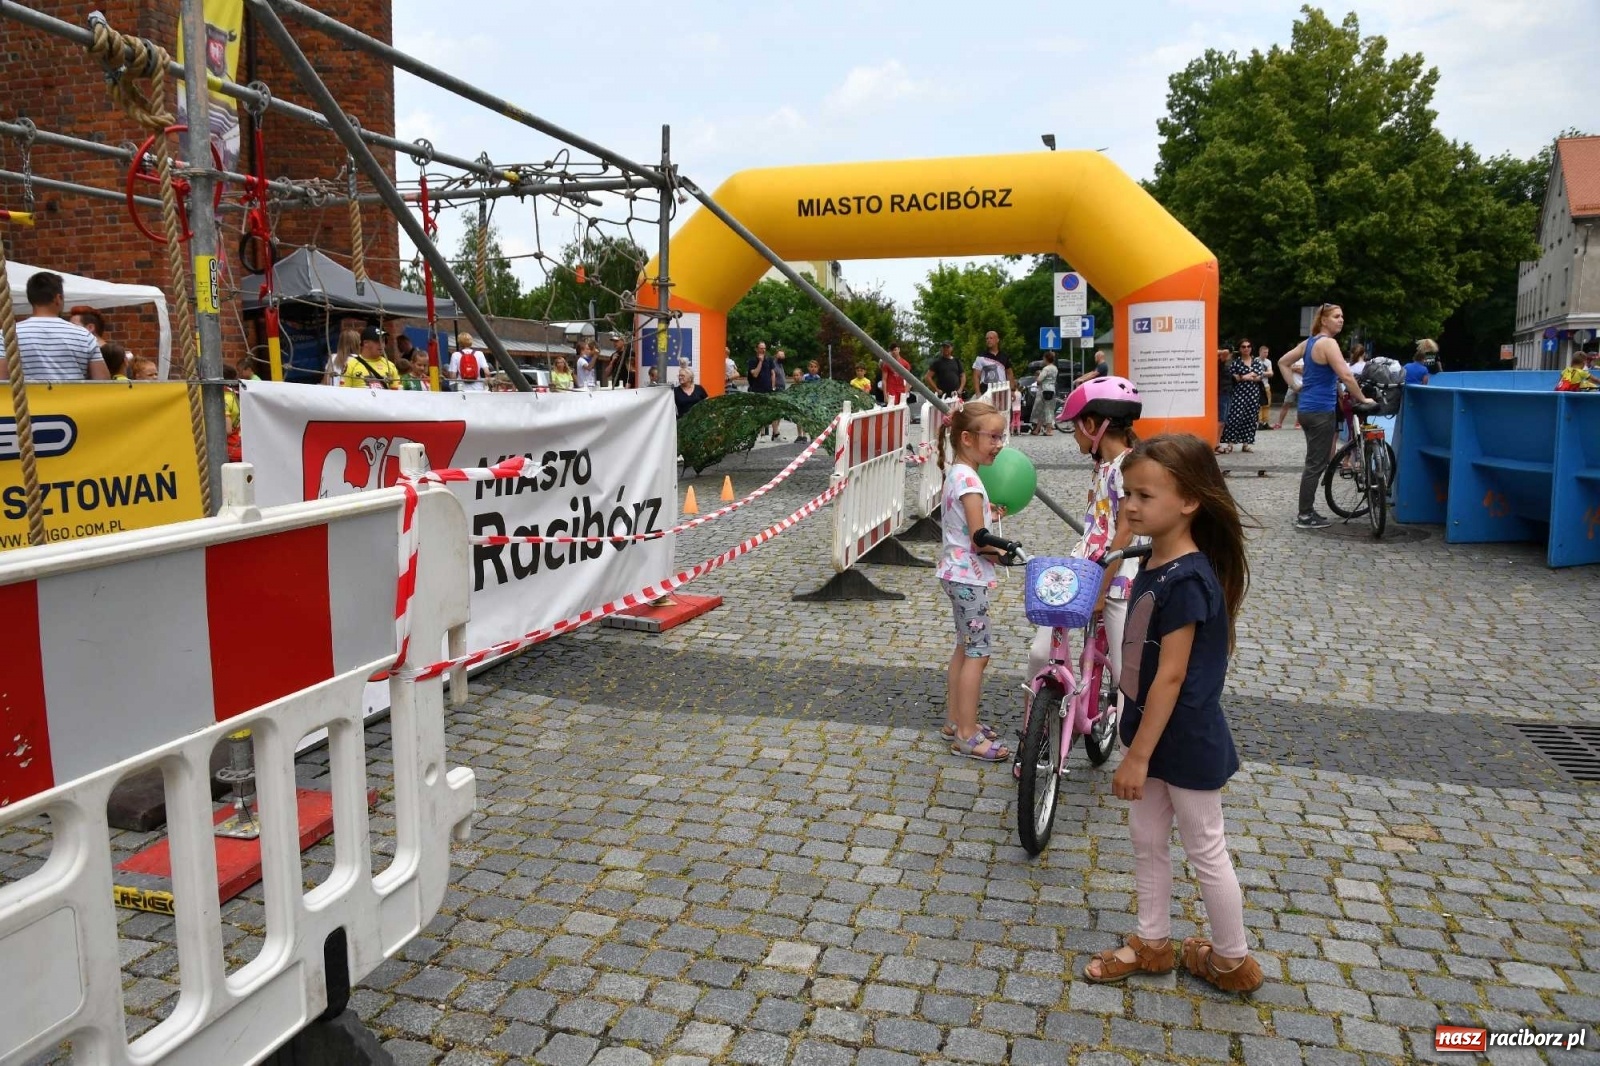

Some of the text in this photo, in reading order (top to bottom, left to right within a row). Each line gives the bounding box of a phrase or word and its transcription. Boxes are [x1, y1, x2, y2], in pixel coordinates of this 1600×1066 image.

[797, 186, 1013, 218] MIASTO RACIBÓRZ
[473, 485, 663, 592] Racibórz
